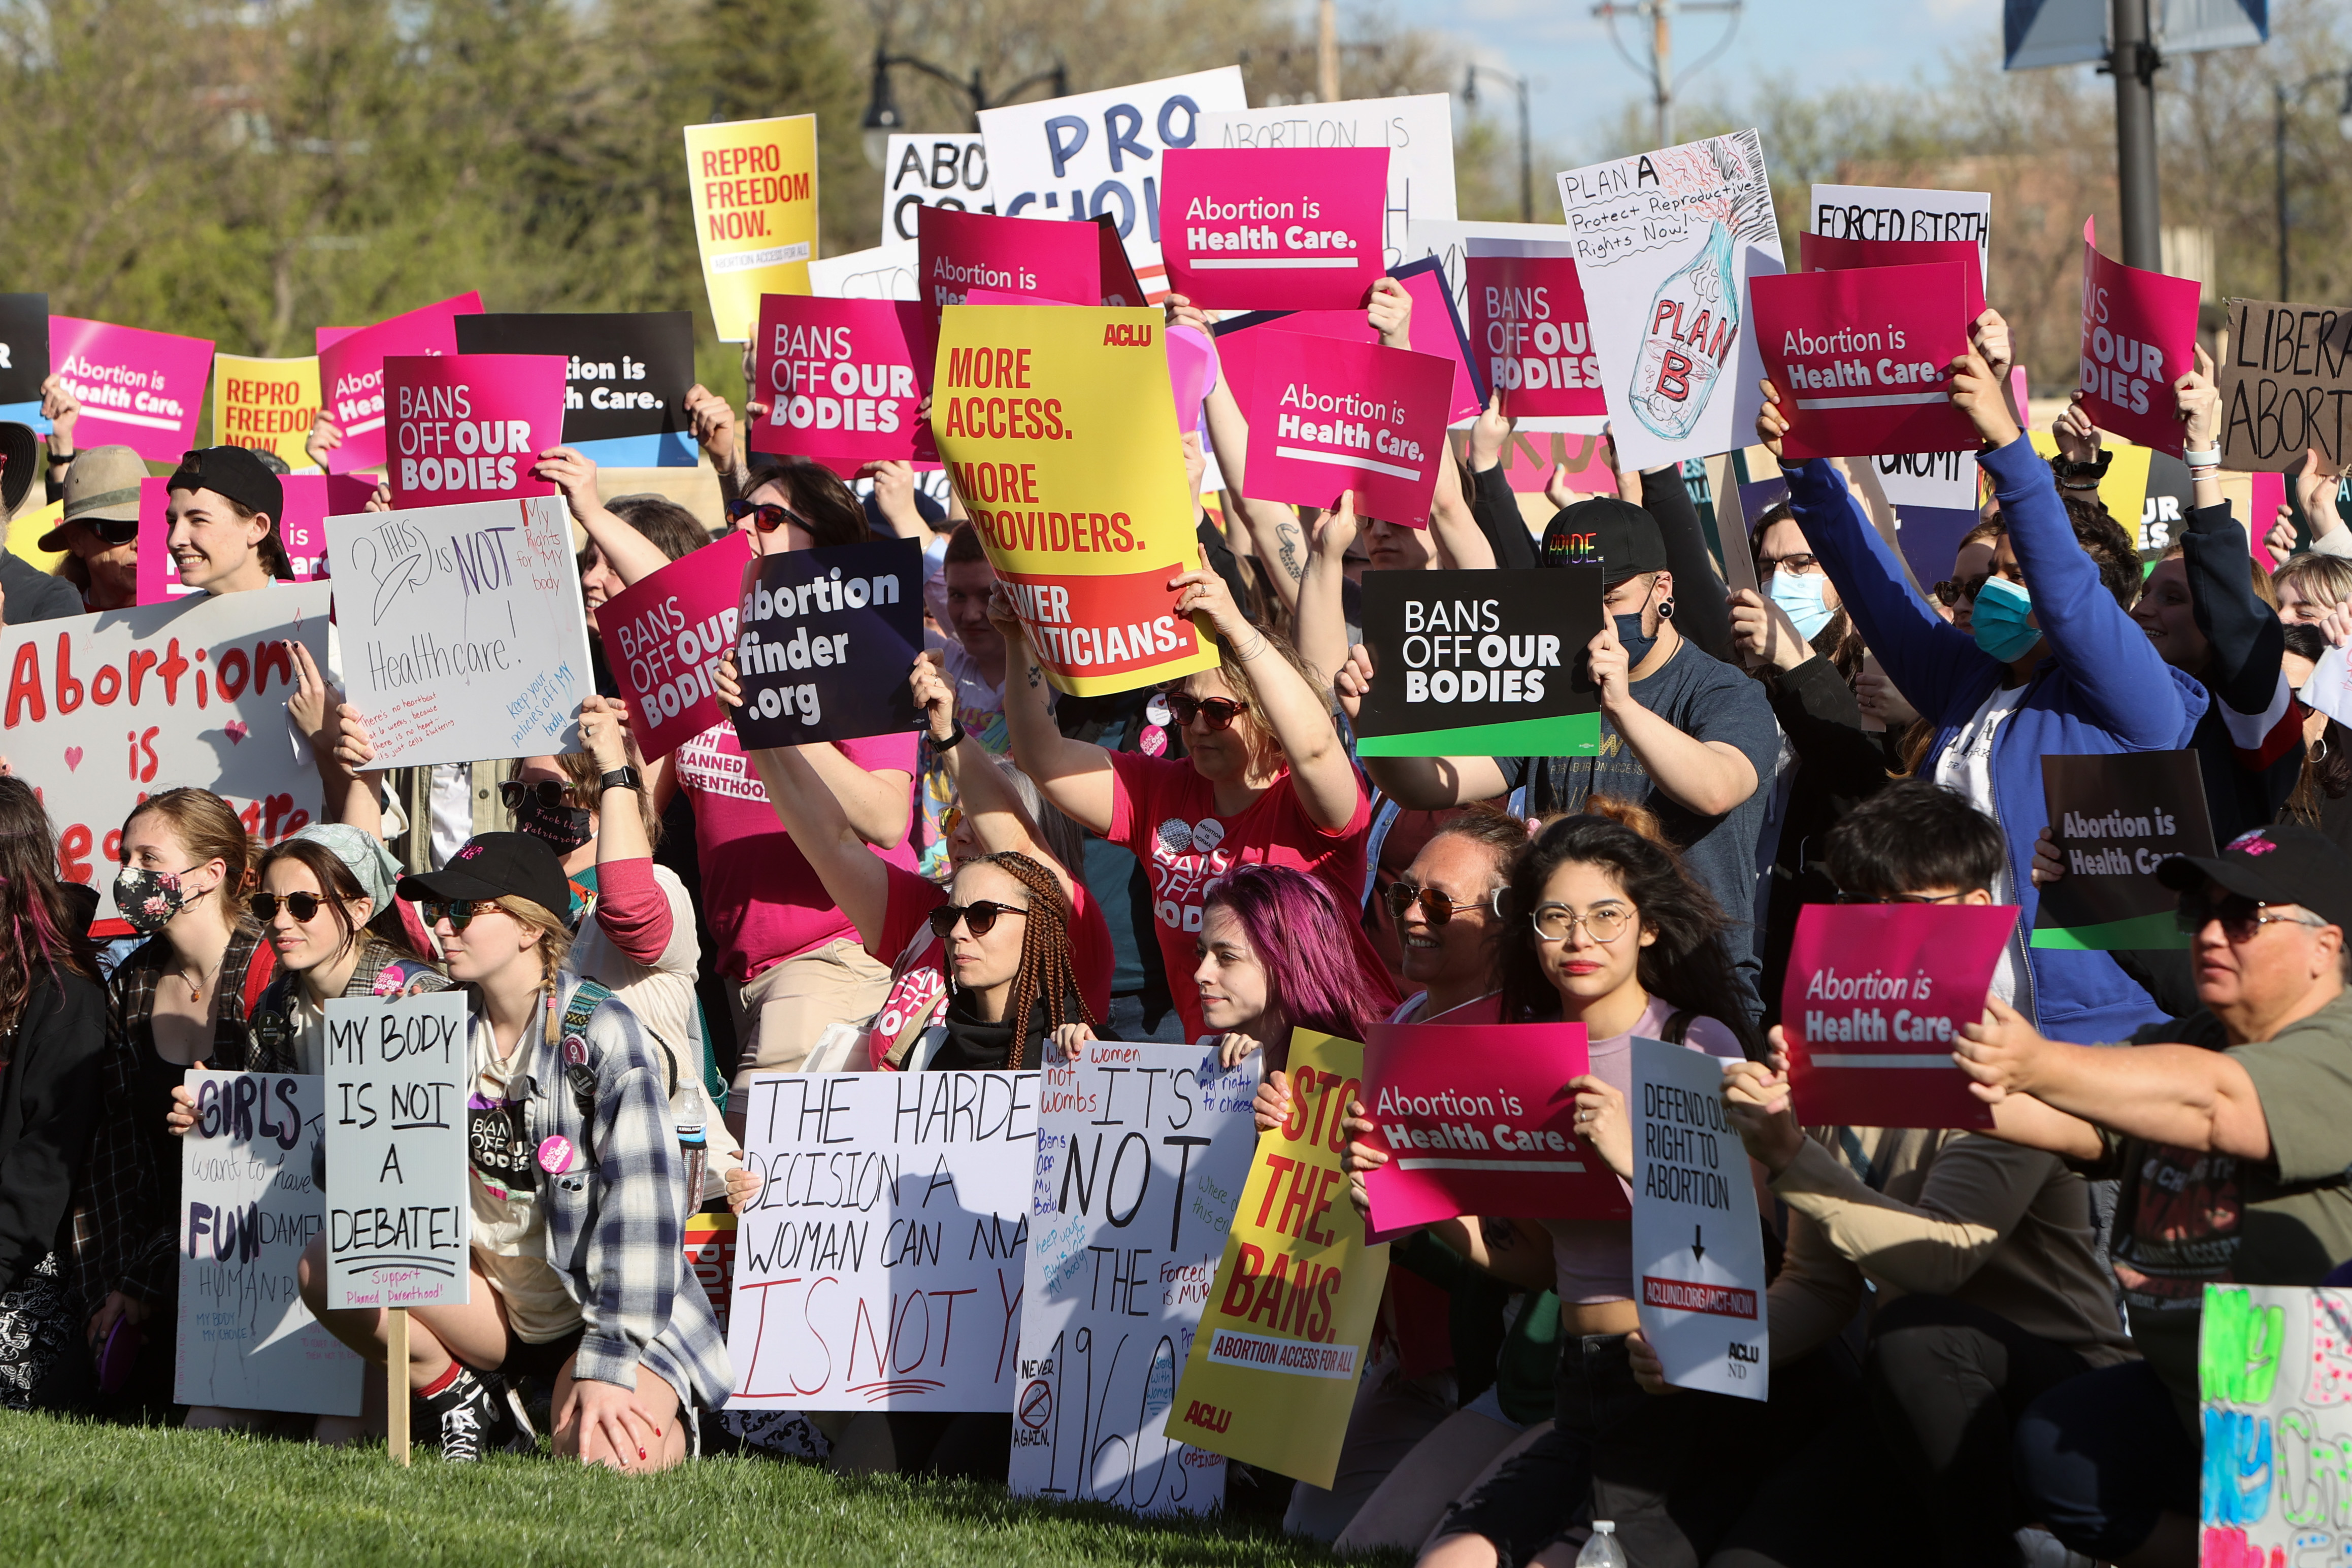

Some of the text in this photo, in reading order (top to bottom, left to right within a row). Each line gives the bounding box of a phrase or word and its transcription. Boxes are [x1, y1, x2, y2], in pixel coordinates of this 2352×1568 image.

[1045, 93, 1201, 179] PRO
[702, 143, 781, 178] REPRO
[705, 172, 810, 209] FREEDOM
[1566, 155, 1660, 203] PLAN A
[1185, 195, 1320, 221] Abortion is
[1572, 180, 1754, 231] Protect Reproductive
[709, 210, 772, 241] NOW.
[1186, 225, 1357, 251] Health Care.
[1577, 218, 1688, 260] Rights Now!
[934, 256, 1011, 289] Abortion
[1018, 266, 1037, 290] is
[1485, 287, 1551, 320] BANS
[774, 324, 852, 361] BANS
[1103, 324, 1152, 347] ACLU
[1486, 321, 1530, 355] OFF
[1783, 324, 1906, 356] Abortion is
[60, 355, 165, 391] Abortion is
[622, 355, 646, 381] is
[771, 358, 915, 397] OFF OUR
[948, 347, 1032, 389] MORE
[1786, 358, 1944, 390] Health Care.
[60, 377, 184, 418] Health Care.
[226, 379, 300, 405] REPRO
[399, 385, 471, 419] BANS
[590, 386, 664, 410] Care.
[1280, 383, 1405, 426] Abortion is
[225, 407, 320, 433] FREEDOM
[770, 394, 900, 433] BODIES
[946, 396, 1073, 440] ACCESS.
[398, 419, 531, 455] OFF OUR
[1278, 413, 1371, 450] Health
[1376, 429, 1425, 462] Care.
[401, 456, 518, 491] BODIES
[952, 461, 1039, 503] MORE
[289, 523, 308, 546] is
[525, 529, 560, 548] Rights
[1548, 532, 1598, 564] PRIDE
[451, 526, 516, 595] NOT
[516, 550, 532, 569] for
[532, 572, 559, 596] body
[741, 566, 900, 624] abortion
[618, 595, 685, 660] BANS
[1404, 598, 1500, 633] BANS
[631, 640, 675, 693] OFF
[737, 625, 849, 676] finder
[1402, 635, 1561, 668] OFF OUR
[4, 631, 292, 729] Abortion
[527, 671, 545, 700] your
[1406, 669, 1546, 704] BODIES
[402, 691, 437, 708] heartbeat
[511, 679, 558, 749] policies off
[748, 683, 821, 726] .org
[369, 730, 376, 740] at
[411, 705, 438, 719] because
[390, 719, 455, 757] just cells fluttering
[542, 712, 567, 737] body
[1151, 730, 1164, 744] OUR
[127, 725, 160, 784] is
[373, 740, 393, 751] there
[395, 732, 403, 741] is
[676, 748, 744, 774] PLANNED
[1199, 822, 1222, 840] ABORTION
[2063, 807, 2177, 840] Abortion is
[1195, 835, 1214, 850] NORMAL
[2068, 848, 2132, 876] Health
[1805, 966, 1933, 1000] Abortion is
[330, 1015, 457, 1065] MY BODY
[1805, 1007, 1961, 1043] Health Care.
[1091, 1048, 1141, 1063] women
[197, 1075, 302, 1151] GIRLS
[338, 1082, 377, 1129] IS
[754, 1076, 860, 1145] THE
[1090, 1067, 1196, 1130] IT'S
[1203, 1091, 1253, 1114] to choose
[1376, 1085, 1523, 1117] Abortion is
[1645, 1082, 1705, 1127] DEFEND
[554, 1139, 568, 1156] OUR
[1038, 1127, 1067, 1152] Bans
[1381, 1123, 1577, 1153] Health Care.
[1646, 1122, 1718, 1170] RIGHT TO
[191, 1150, 266, 1183] want to
[380, 1143, 404, 1184] A
[541, 1146, 556, 1165] BANS
[550, 1146, 571, 1172] BODIES
[1036, 1154, 1054, 1176] Off
[743, 1151, 960, 1215] DECISION A
[1034, 1178, 1052, 1201] My
[1057, 1132, 1212, 1253] NOT
[1254, 1152, 1342, 1248] THE.
[1645, 1162, 1730, 1211] ABORTION
[1033, 1196, 1058, 1222] Body
[1192, 1196, 1213, 1223] this
[331, 1206, 460, 1253] DEBATE!
[1073, 1225, 1085, 1253] off
[746, 1219, 943, 1275] WOMAN CAN
[371, 1268, 421, 1288] Support
[1087, 1245, 1152, 1317] THE
[1159, 1253, 1207, 1283] Forced
[347, 1289, 380, 1305] Planned
[1162, 1286, 1173, 1306] is
[1219, 1242, 1342, 1344] BANS.
[1646, 1281, 1753, 1315] ACLUND.ORG/ACT-NOW
[730, 1277, 838, 1398] IS
[847, 1288, 978, 1382] NOT
[1213, 1335, 1277, 1365] ABORTION
[1278, 1347, 1318, 1371] ACCESS
[1319, 1349, 1338, 1371] FOR
[1337, 1351, 1352, 1373] ALL
[1728, 1341, 1760, 1363] ACLU
[1021, 1358, 1055, 1380] NEVER
[1151, 1370, 1170, 1383] with
[1728, 1362, 1747, 1380] ND
[1183, 1400, 1233, 1433] ACLU
[1013, 1428, 1049, 1448] AGAIN.
[1184, 1452, 1226, 1469] OPINION
